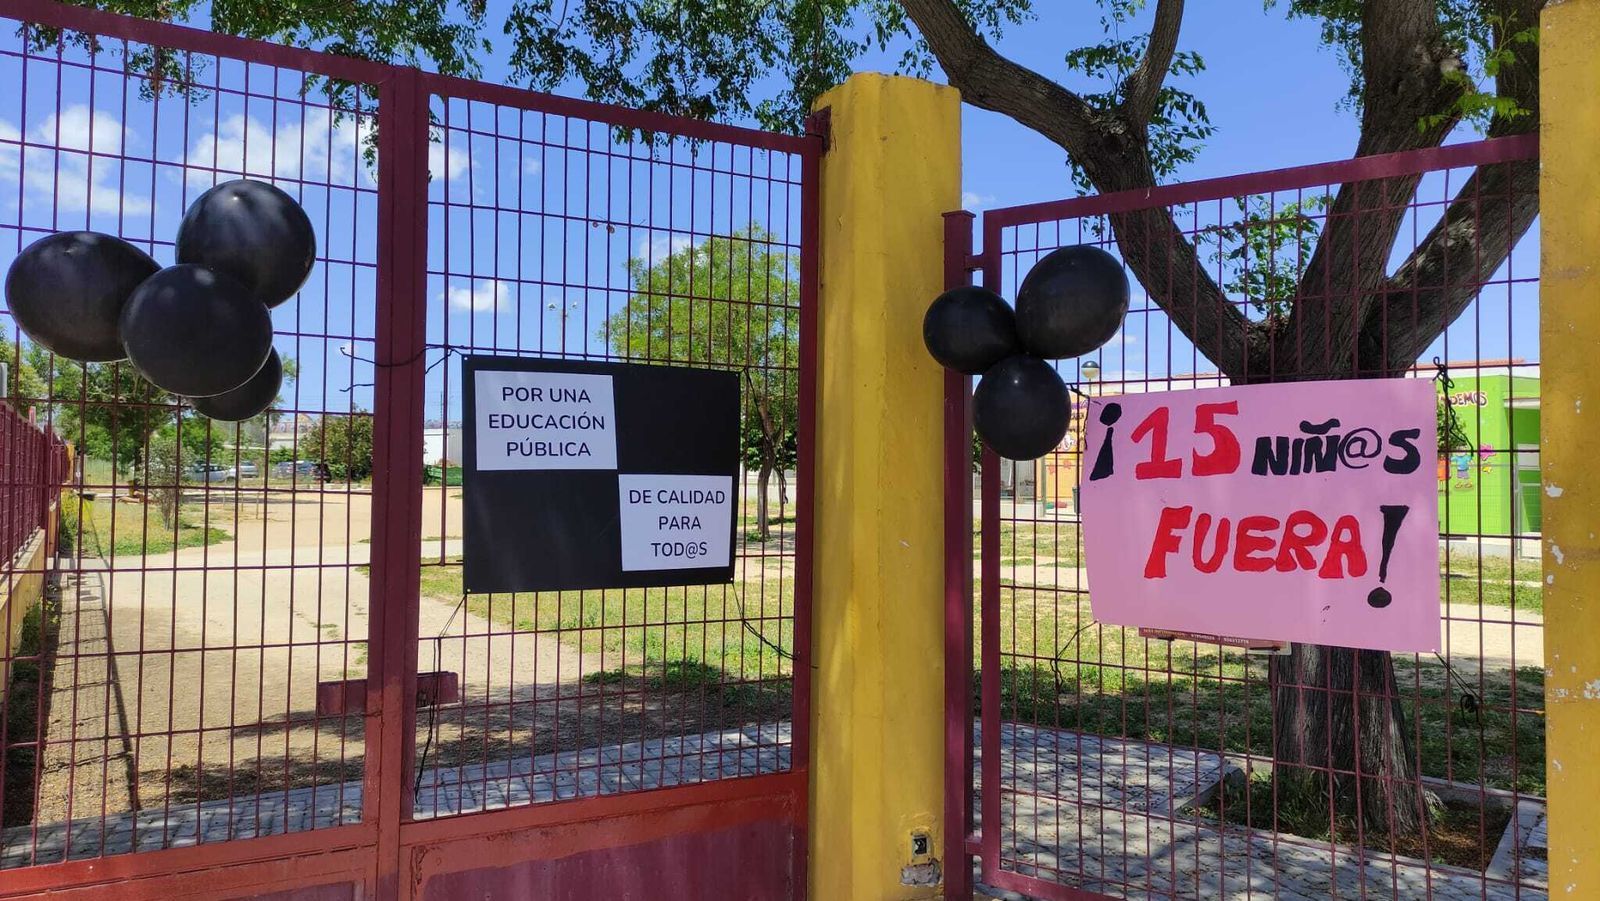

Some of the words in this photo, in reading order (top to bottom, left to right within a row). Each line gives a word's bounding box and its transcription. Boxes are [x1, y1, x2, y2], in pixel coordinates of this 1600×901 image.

[502, 386, 543, 402] POR
[550, 389, 591, 404] UNA
[489, 411, 605, 430] EDUCACIÓN
[506, 437, 592, 457] PÚBLICA
[1252, 419, 1421, 476] NIÑ@S
[629, 490, 652, 504] DE
[657, 490, 726, 505] CALIDAD
[658, 516, 702, 531] PARA
[652, 541, 708, 559] TOD@S
[1144, 505, 1410, 608] FUERA!
